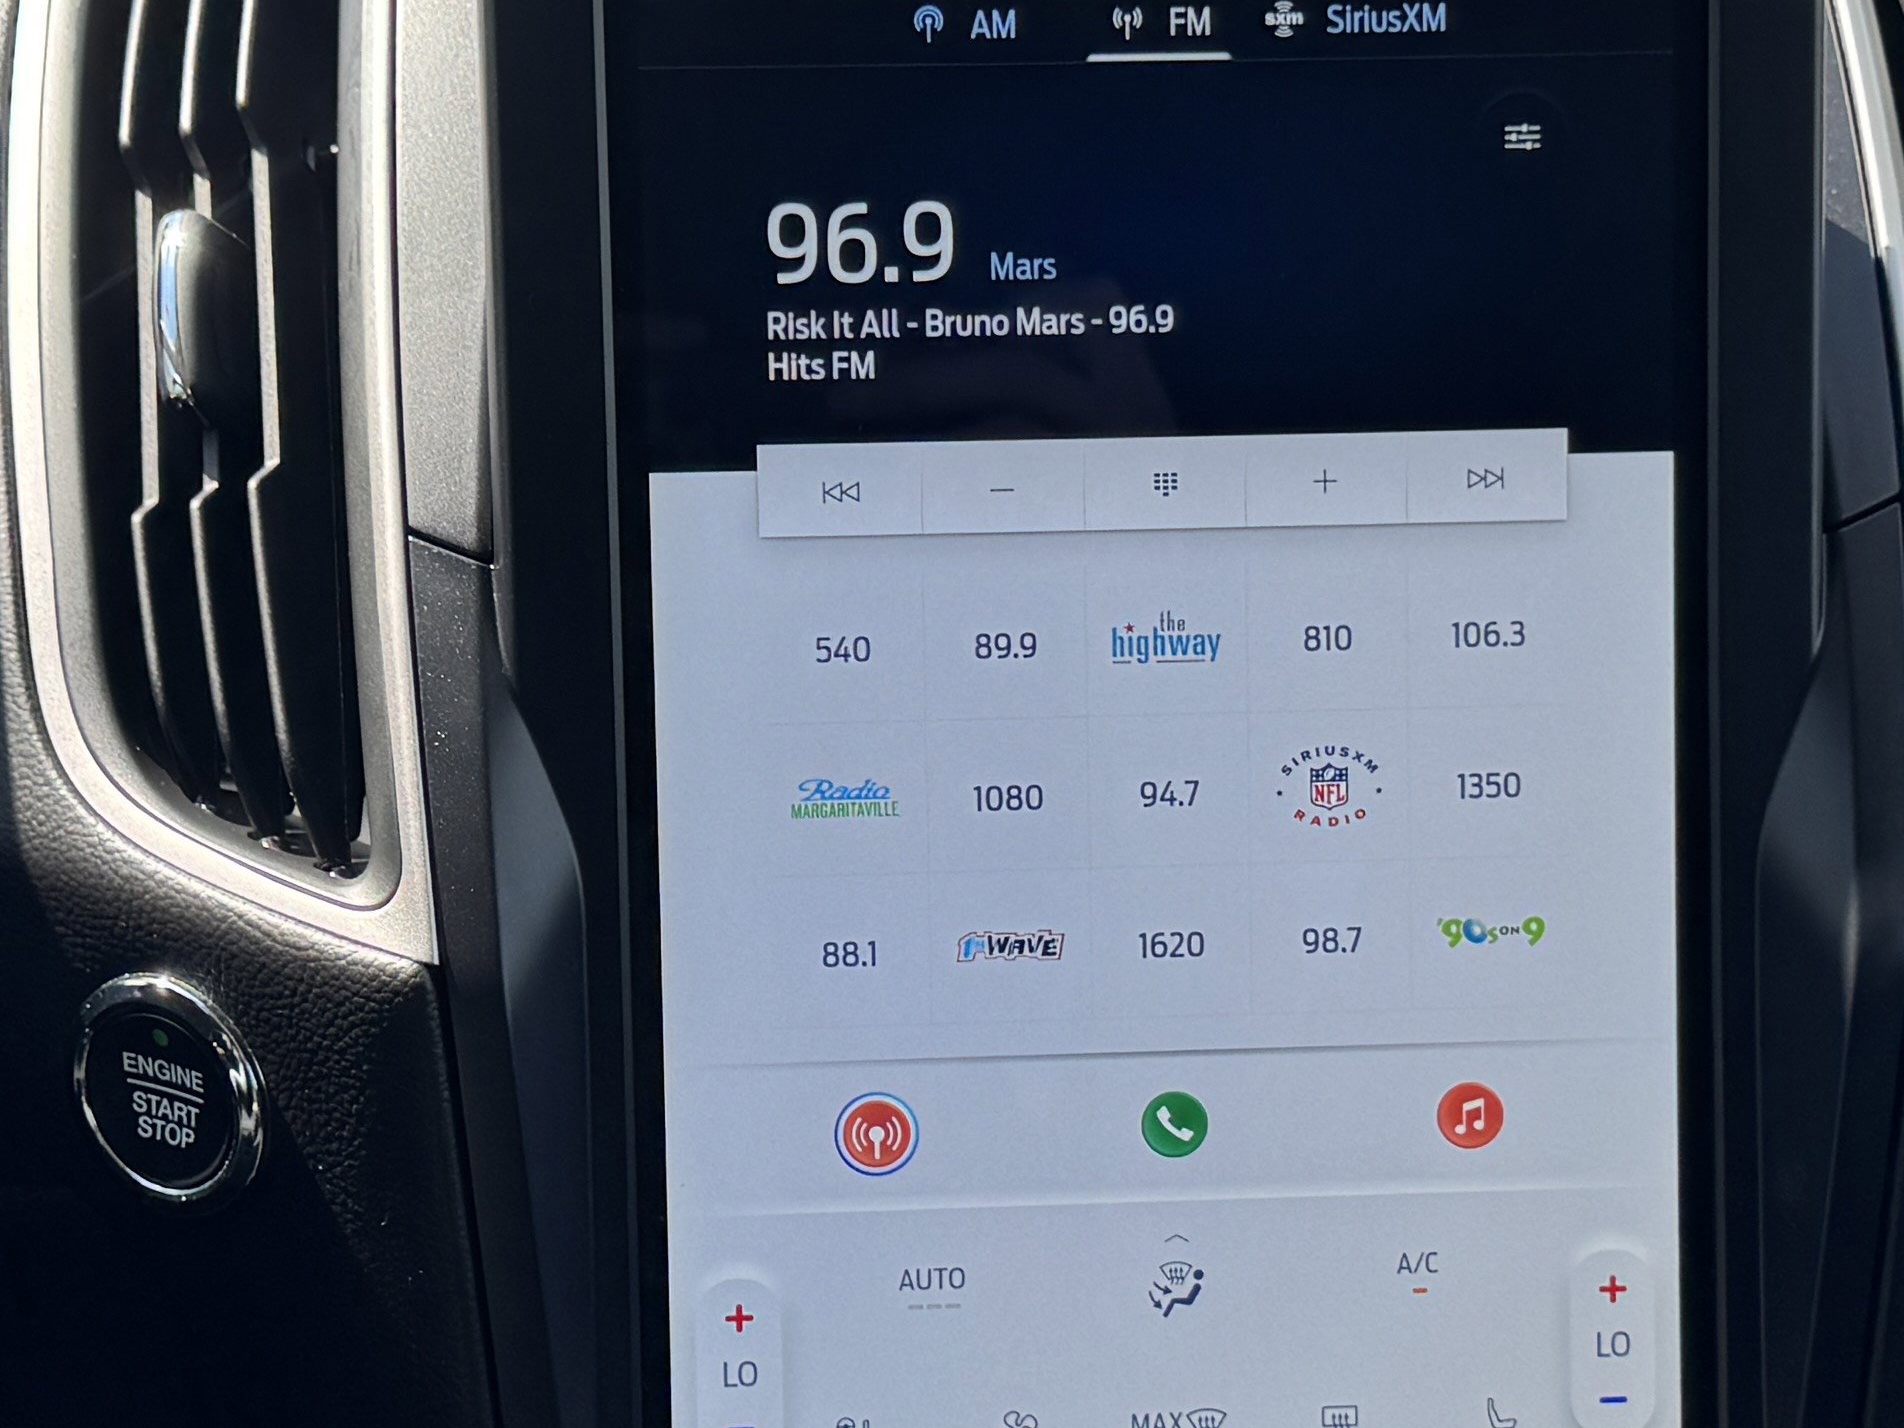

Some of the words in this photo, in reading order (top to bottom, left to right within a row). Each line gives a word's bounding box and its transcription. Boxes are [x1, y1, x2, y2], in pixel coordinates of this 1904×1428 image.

[970, 9, 1016, 39] AM
[1169, 6, 1212, 38] FM
[1326, 2, 1446, 33] SiriusXM
[767, 200, 954, 285] 96.9
[990, 252, 1057, 281] Mars
[766, 310, 827, 340] Risk
[833, 310, 854, 339] It
[860, 309, 900, 339] All
[925, 308, 1010, 337] Bruno
[1016, 306, 1085, 336] Mars
[1109, 304, 1174, 334] 96.9
[767, 351, 826, 381] Hits
[832, 350, 875, 380] FM
[1158, 610, 1186, 633] the
[1451, 620, 1527, 650] 106.3
[814, 635, 871, 664] 540
[974, 632, 1038, 661] 89.9
[1112, 626, 1221, 664] highway
[1303, 624, 1353, 653] 810
[1281, 745, 1379, 777] SIRIUSXM
[798, 778, 892, 802] Radio
[972, 783, 1044, 812] 1080
[1139, 779, 1200, 809] 94.7
[1313, 783, 1346, 805] NFL
[1456, 771, 1522, 800] 1350
[790, 800, 900, 820] MARGARITAVILLE
[1293, 808, 1367, 828] RADIO
[822, 940, 878, 968] 88.1
[1139, 930, 1205, 960] 1620
[1302, 926, 1363, 954] 98.7
[122, 1051, 204, 1093] ENGINE
[132, 1091, 200, 1128] START
[137, 1116, 195, 1148] STOP
[898, 1266, 966, 1292] AUTO
[1396, 1252, 1439, 1277] A/C
[1595, 1330, 1631, 1358] LO
[724, 1361, 758, 1389] LO
